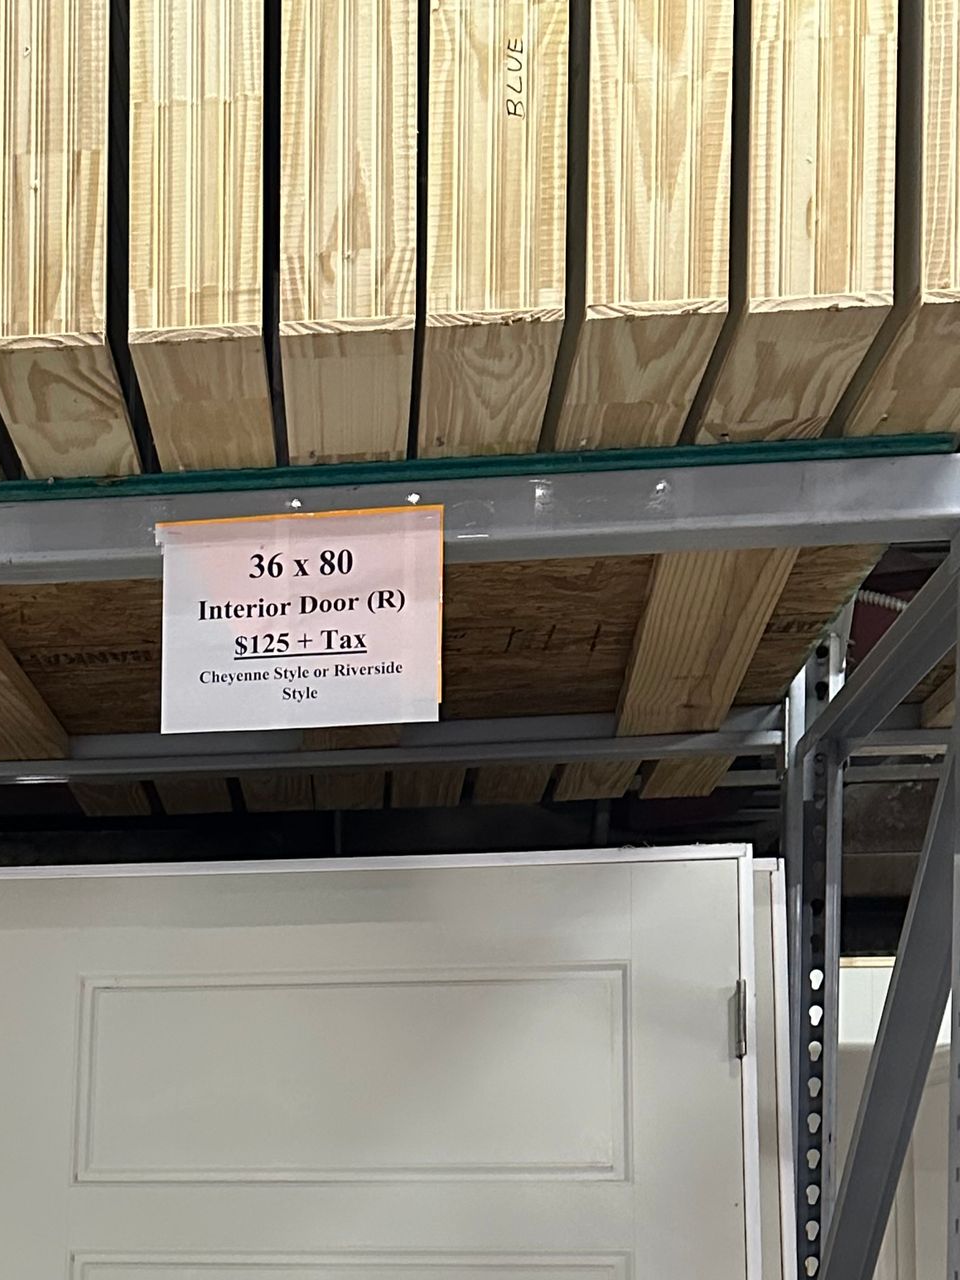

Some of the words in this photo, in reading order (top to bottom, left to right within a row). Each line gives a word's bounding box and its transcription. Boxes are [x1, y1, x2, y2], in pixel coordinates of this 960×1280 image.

[506, 38, 526, 120] BLUE
[249, 553, 283, 578] 36
[293, 558, 309, 577] x
[319, 549, 353, 575] 80
[198, 598, 291, 620] Interior
[300, 596, 359, 614] Door
[368, 589, 405, 614] (R)
[234, 633, 289, 656] $125
[298, 634, 313, 649] +
[320, 630, 367, 649] Tax
[200, 669, 269, 685] Cheyenne
[274, 666, 309, 682] Style
[314, 668, 328, 678] or
[334, 662, 402, 676] Riverside
[282, 687, 318, 702] Style
